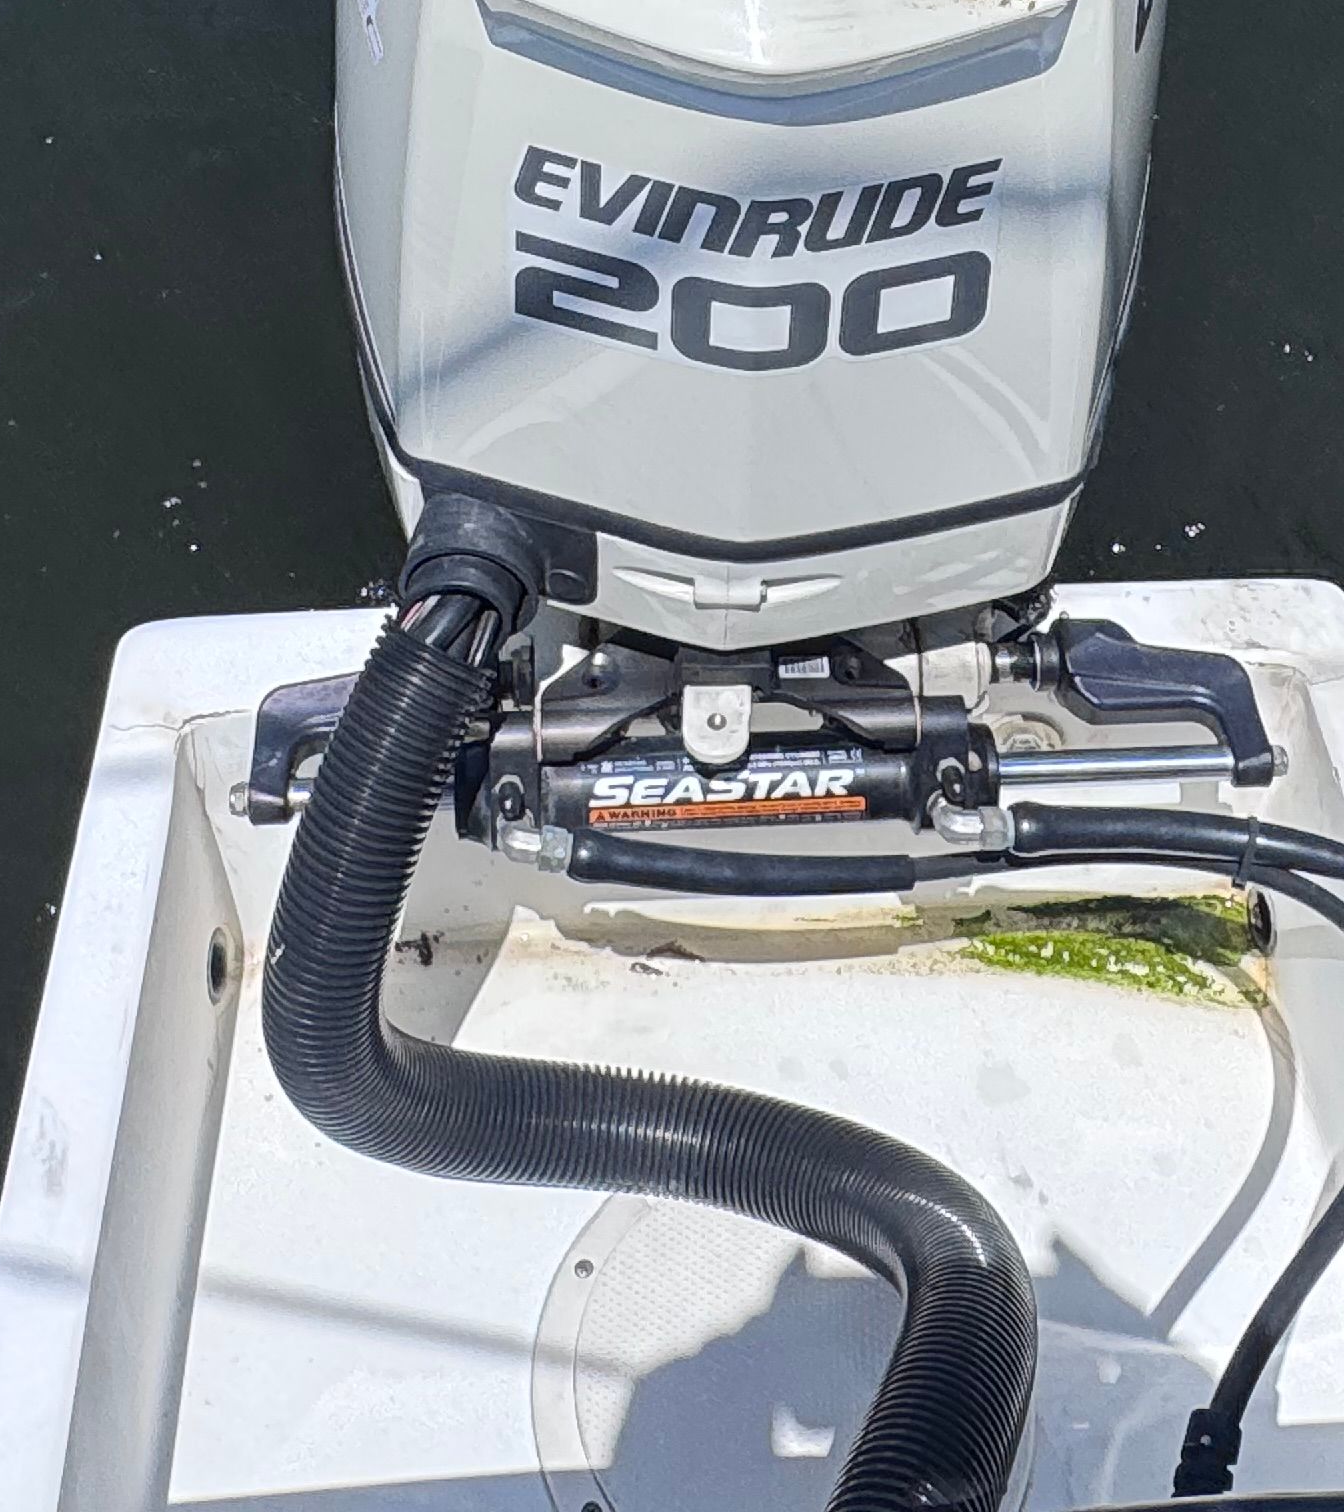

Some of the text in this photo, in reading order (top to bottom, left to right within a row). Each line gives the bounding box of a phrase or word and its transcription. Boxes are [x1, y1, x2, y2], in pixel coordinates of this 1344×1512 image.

[514, 145, 1002, 258] EVINRUDE
[514, 231, 992, 371] 200
[589, 769, 855, 808] SEASTAR
[608, 808, 678, 820] WARNING
